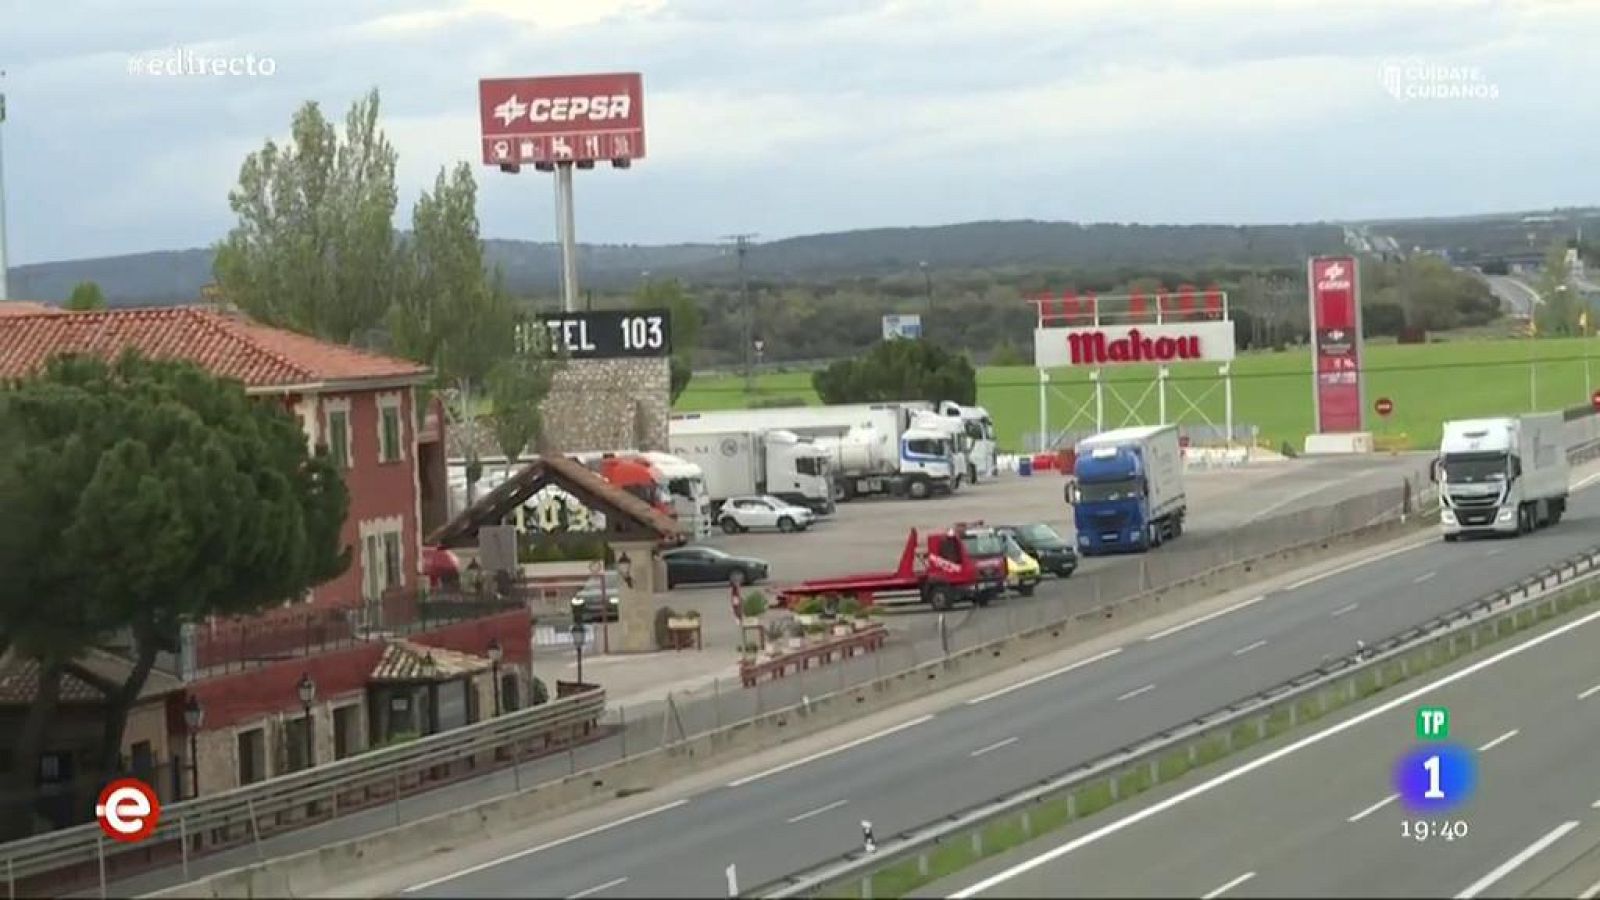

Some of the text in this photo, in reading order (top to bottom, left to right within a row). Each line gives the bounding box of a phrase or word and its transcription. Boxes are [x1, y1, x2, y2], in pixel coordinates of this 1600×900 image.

[529, 95, 631, 123] CEPSA
[620, 316, 663, 350] 103
[1067, 328, 1202, 365] Mahou
